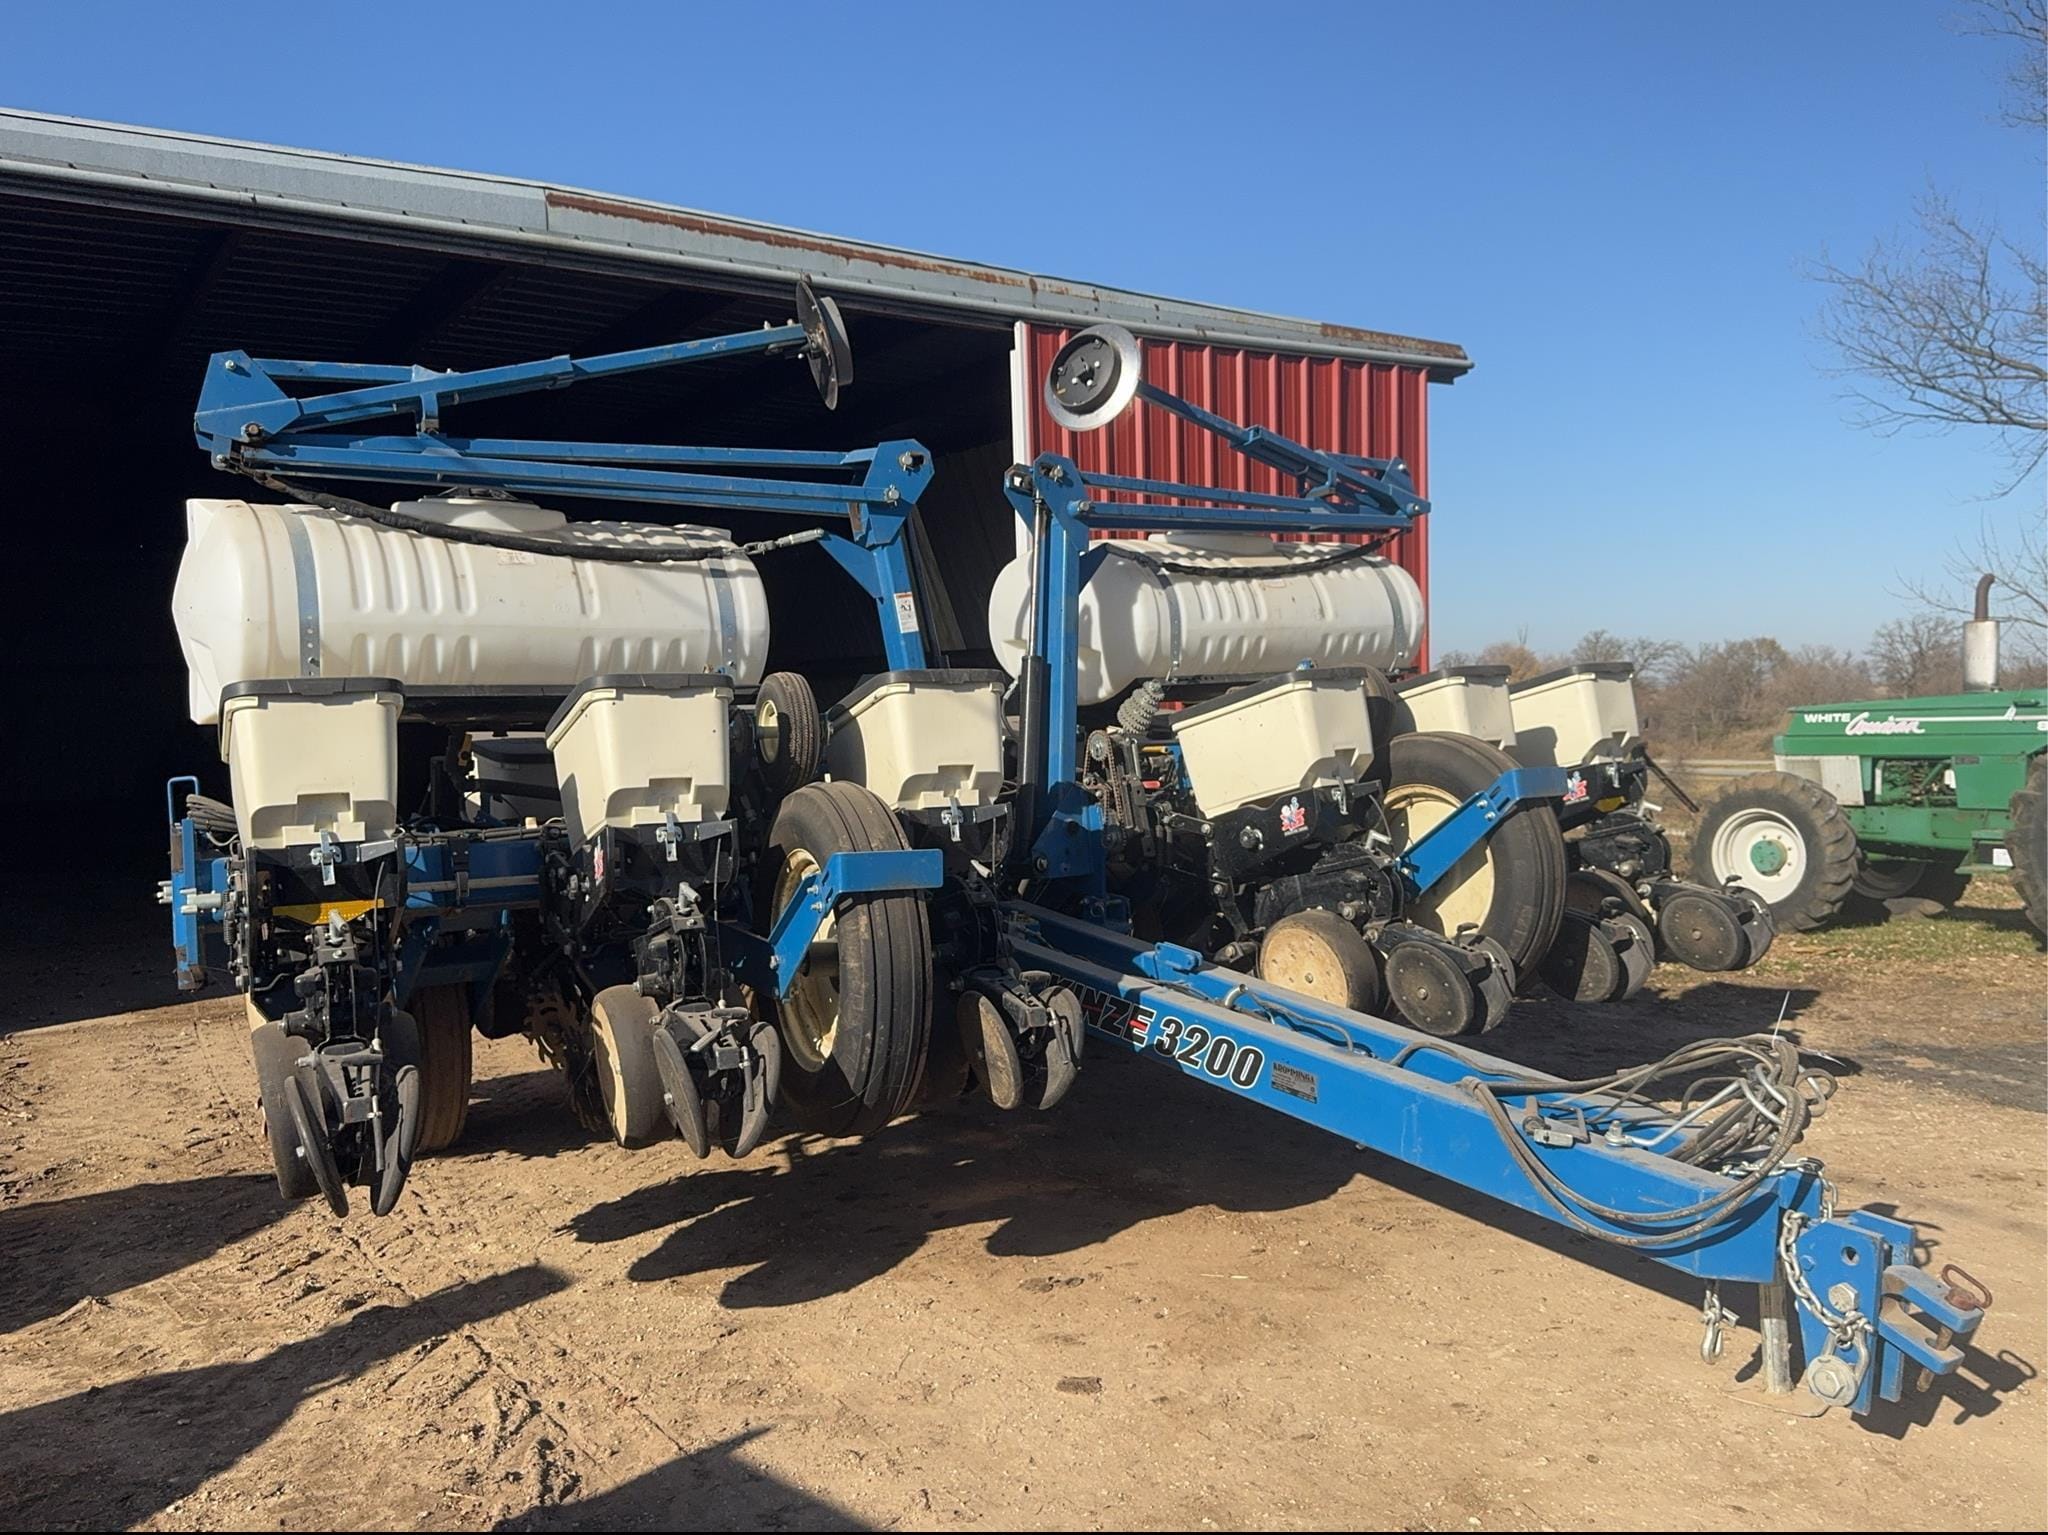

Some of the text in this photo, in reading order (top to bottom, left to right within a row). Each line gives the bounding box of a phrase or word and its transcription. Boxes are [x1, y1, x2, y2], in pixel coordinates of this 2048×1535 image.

[1804, 713, 1851, 723] WHITE
[1050, 973, 1157, 1048] NZE
[1154, 1015, 1265, 1089] 3200
